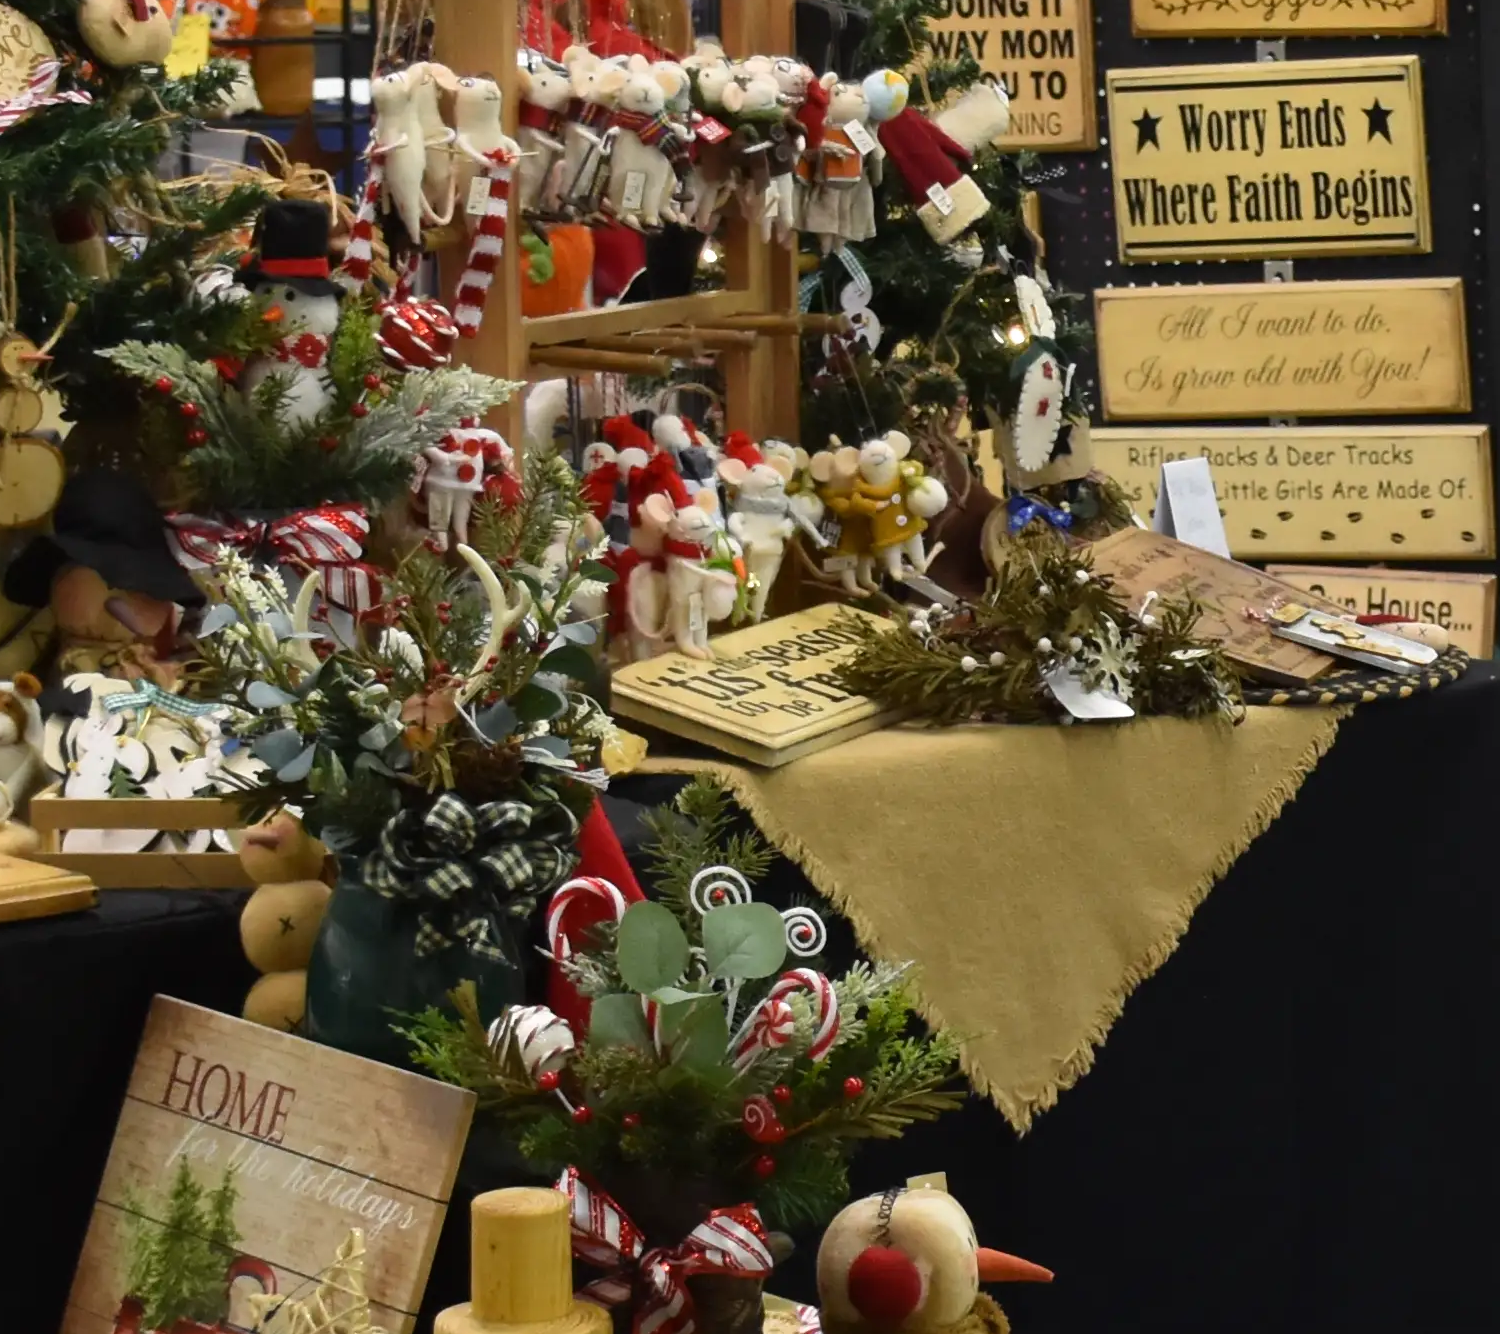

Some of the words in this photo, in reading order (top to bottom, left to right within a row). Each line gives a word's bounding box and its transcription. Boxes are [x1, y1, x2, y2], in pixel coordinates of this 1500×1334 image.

[930, 30, 988, 61] WAY
[1001, 29, 1074, 59] MOM
[1030, 71, 1067, 100] TO
[1178, 103, 1268, 161] Worry
[1279, 99, 1347, 151] Ends
[1122, 176, 1218, 226] Where
[1227, 174, 1303, 223] Faith
[1312, 168, 1415, 229] Begins
[1159, 303, 1214, 343] All
[1257, 309, 1316, 337] want
[1322, 308, 1347, 335] to
[1124, 356, 1165, 392] Is
[1167, 369, 1235, 406] grow
[1243, 354, 1287, 388] old
[1292, 352, 1345, 385] with
[1350, 346, 1431, 399] You!
[1200, 446, 1258, 468] Racks
[1265, 446, 1278, 466] &
[1287, 446, 1336, 467] Deer
[1345, 444, 1413, 466] Tracks
[1213, 479, 1268, 502] Little
[1276, 479, 1324, 502] Girls
[1332, 480, 1369, 500] Are
[1377, 479, 1431, 499] Made
[1439, 479, 1474, 500] Of.
[159, 1050, 297, 1145] HOME
[164, 1111, 221, 1170] for
[228, 1117, 274, 1185] the
[283, 1142, 420, 1243] holidays
